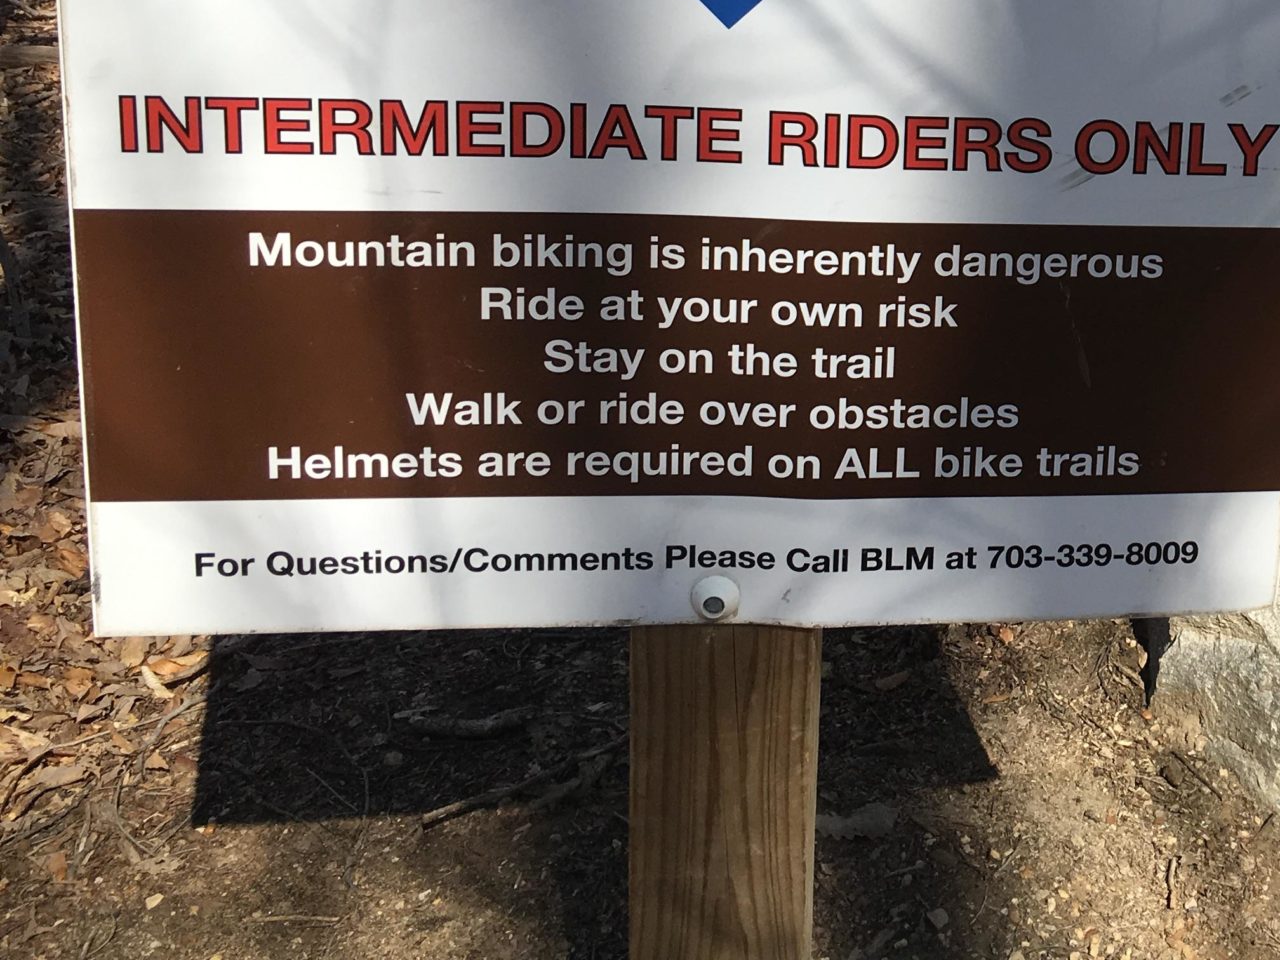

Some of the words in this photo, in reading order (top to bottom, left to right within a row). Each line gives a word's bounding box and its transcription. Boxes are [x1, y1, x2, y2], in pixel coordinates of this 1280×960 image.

[118, 95, 743, 163] INTERMEDIATE
[768, 110, 1053, 173] RIDERS
[1074, 118, 1280, 177] ONLY
[248, 232, 476, 267] Mountain
[493, 234, 633, 277] biking
[649, 236, 686, 270] is
[701, 238, 921, 284] inherently
[933, 244, 1164, 286] dangerous
[480, 287, 585, 321] Ride
[599, 290, 645, 321] at
[657, 295, 758, 329] your
[771, 299, 863, 328] own
[878, 295, 958, 328] risk
[543, 339, 646, 381] Stay
[658, 347, 713, 374] on
[728, 343, 798, 378] the
[811, 346, 895, 379] trail
[405, 392, 523, 426] Walk
[537, 399, 585, 425] or
[600, 392, 685, 425] ride
[699, 399, 796, 428] over
[809, 396, 1020, 430] obstacles
[268, 445, 463, 480] Helmets
[477, 449, 552, 478] are
[567, 444, 753, 484] required
[768, 452, 821, 480] on
[834, 447, 921, 480] ALL
[935, 446, 1023, 478] bike
[1036, 445, 1140, 478] trails
[194, 552, 255, 577] For
[266, 545, 654, 577] Questions/Comments
[665, 544, 775, 570] Please
[786, 547, 848, 573] Call
[860, 546, 935, 572] BLM
[945, 545, 977, 570] at
[987, 540, 1198, 570] 703-339-8009
